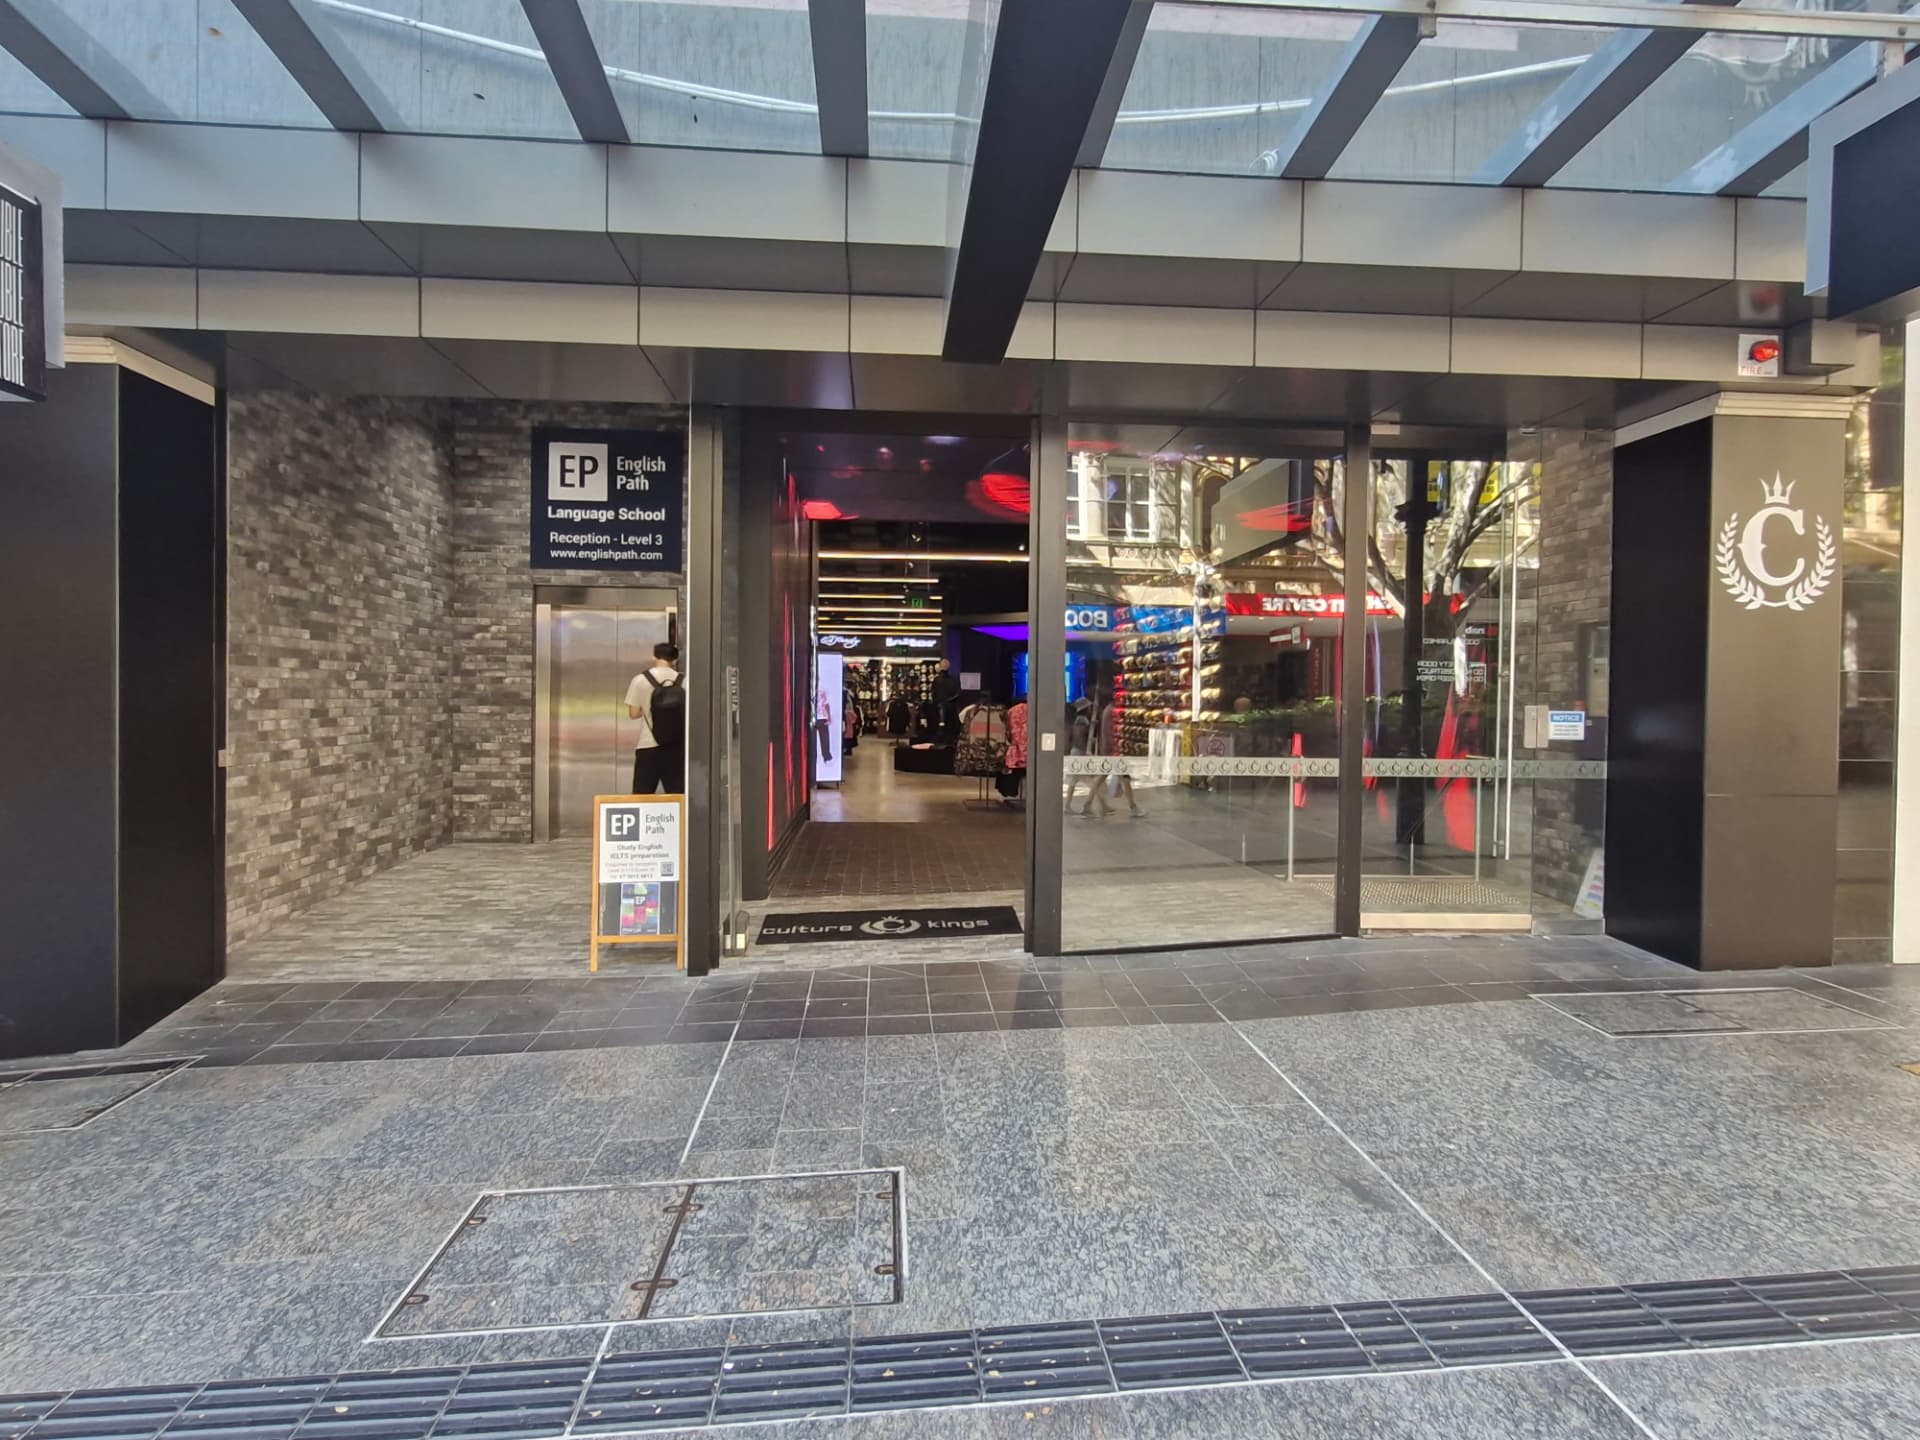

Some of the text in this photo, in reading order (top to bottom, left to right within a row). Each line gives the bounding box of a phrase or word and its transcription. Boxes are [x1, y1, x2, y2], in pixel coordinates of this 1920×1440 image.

[559, 454, 599, 488] EP
[616, 456, 666, 475] English
[616, 476, 649, 491] Path
[548, 506, 666, 523] Language School
[549, 532, 611, 547] Reception
[621, 533, 652, 545] Level
[655, 534, 663, 546] 3
[550, 549, 663, 561] www.englishpath.com
[611, 814, 636, 835] EP
[645, 814, 675, 825] English
[645, 825, 665, 834] Path
[762, 924, 853, 935] culture
[928, 918, 989, 930] kings
